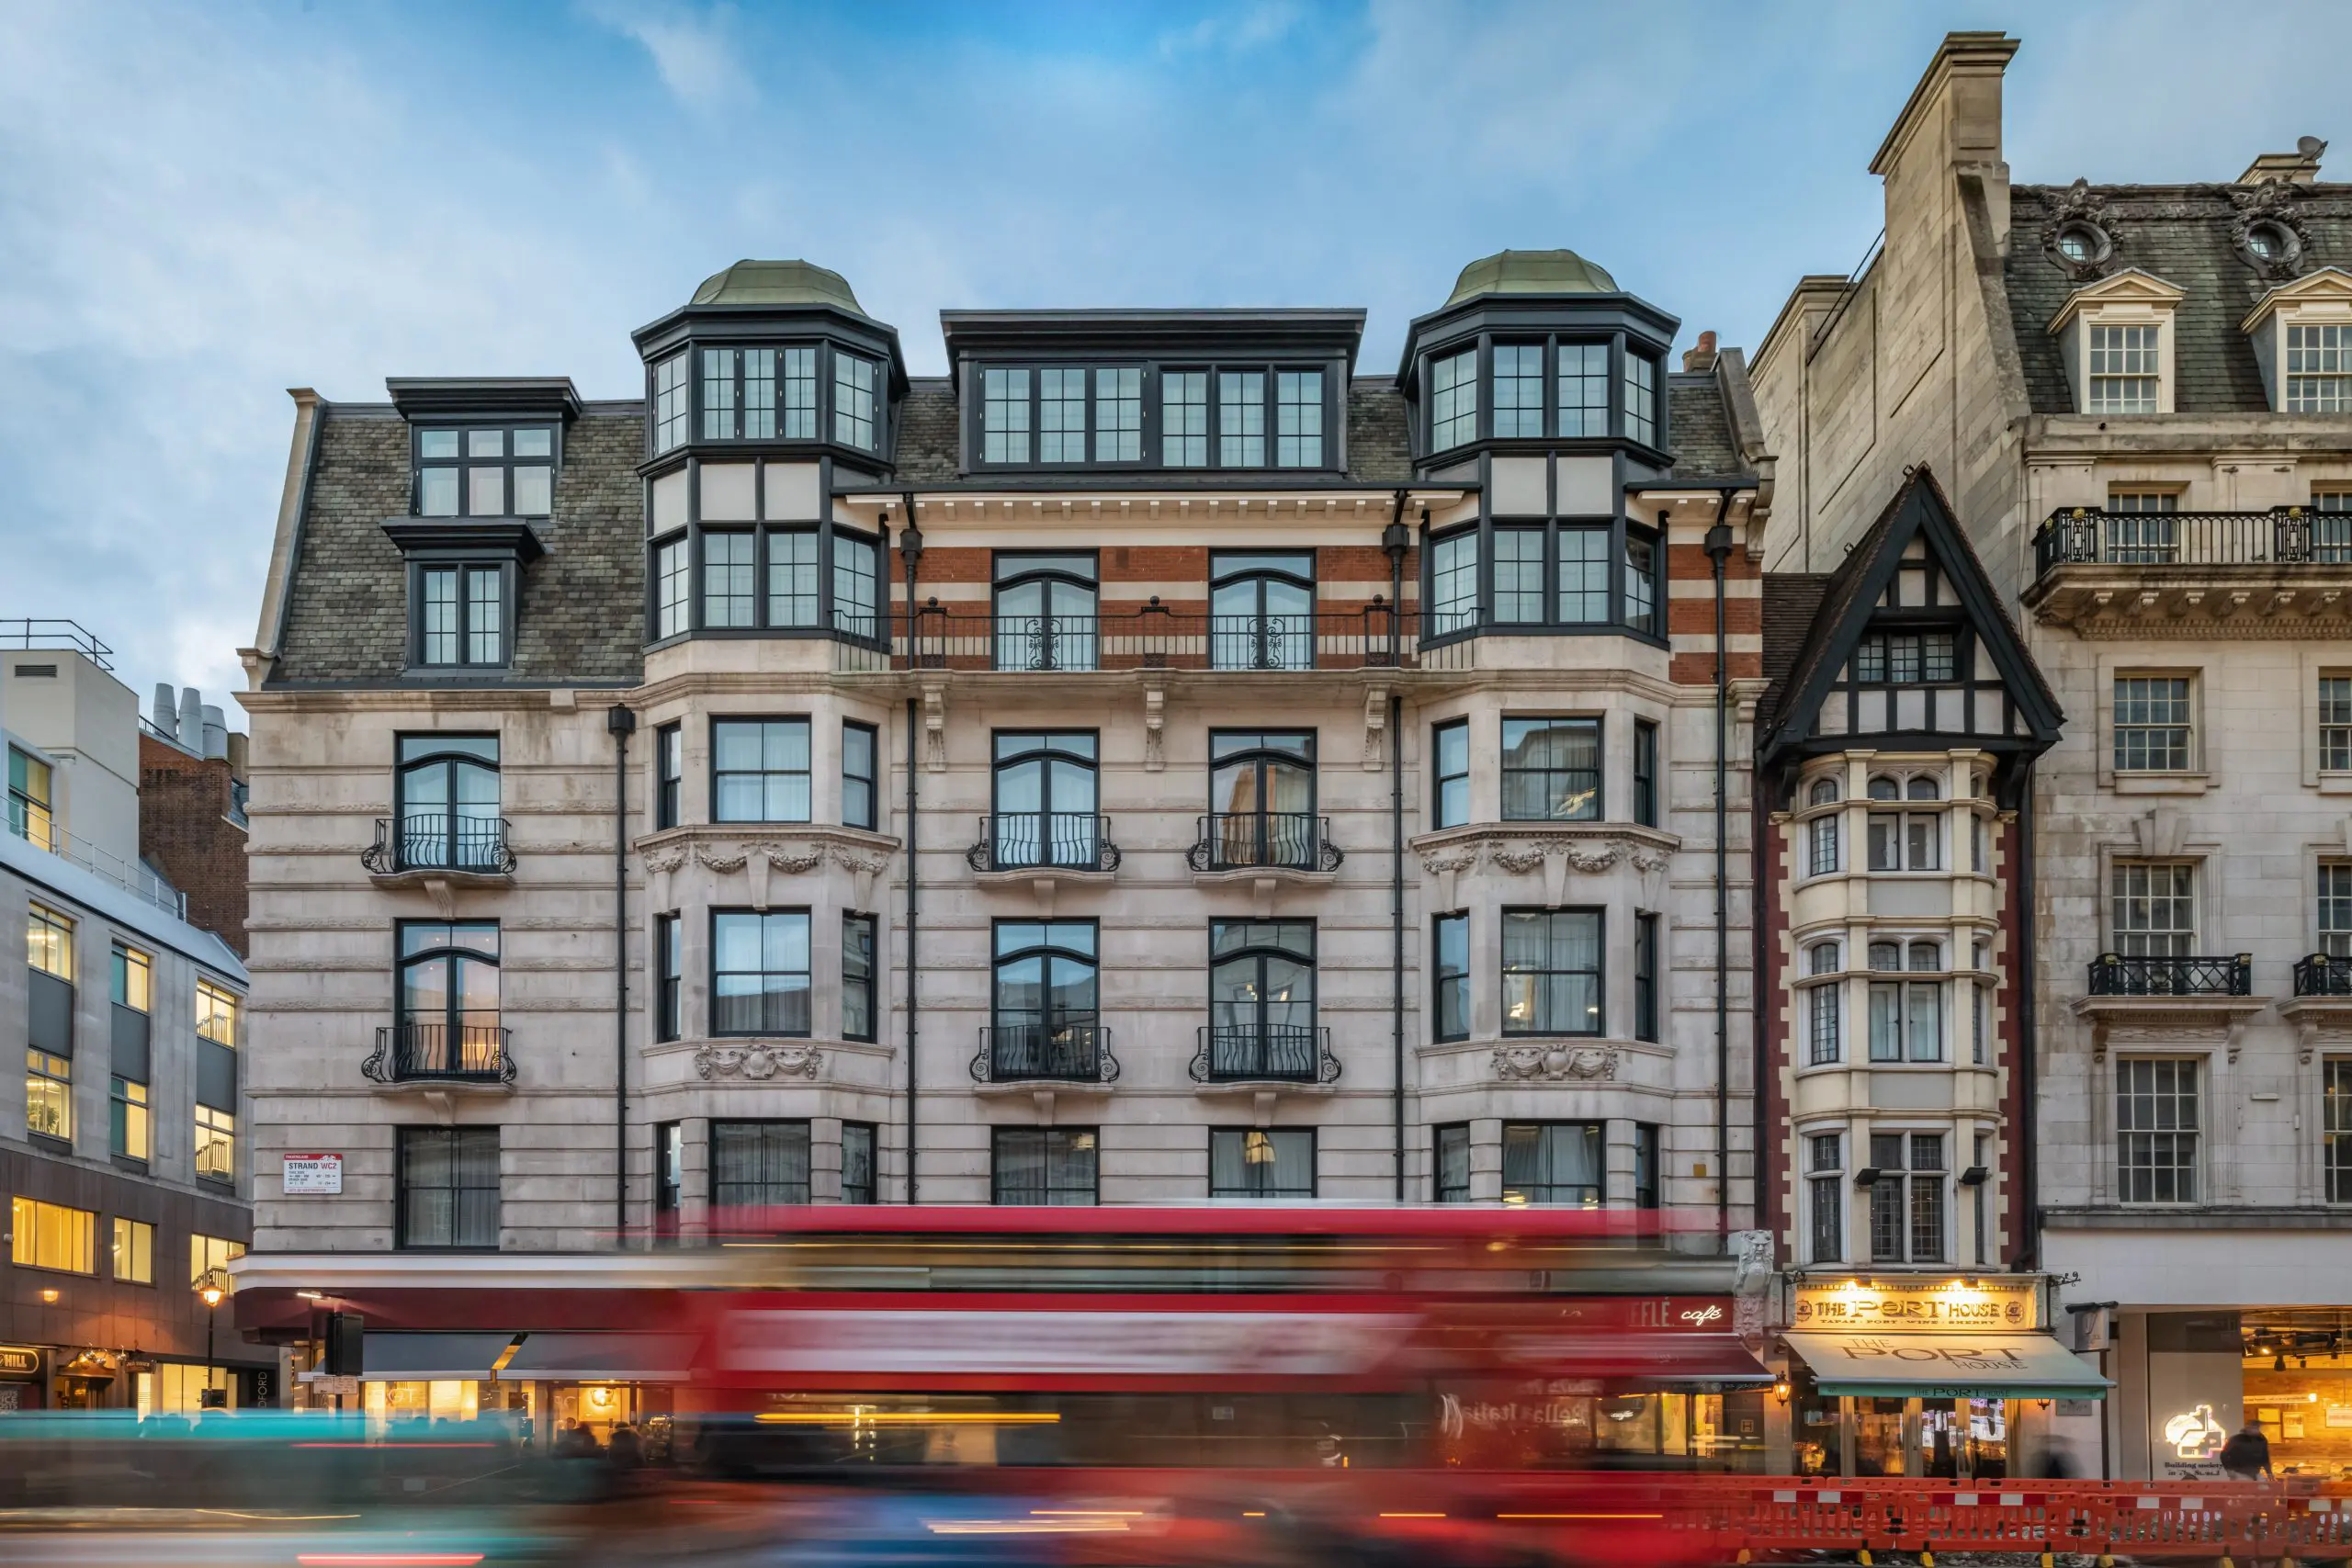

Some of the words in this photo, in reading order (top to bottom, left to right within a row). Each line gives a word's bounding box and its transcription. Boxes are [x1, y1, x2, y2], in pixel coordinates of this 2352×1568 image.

[1815, 1301, 1847, 1316] THE
[1850, 1299, 1945, 1317] PORT
[1949, 1302, 2000, 1317] HOUSE
[1680, 1304, 1722, 1326] café
[1847, 1337, 1894, 1348] THE
[1840, 1346, 2025, 1361] PORT
[4, 1354, 27, 1368] HILL
[1951, 1360, 2030, 1370] HOUSE
[1915, 1388, 1929, 1396] THE
[1933, 1388, 1983, 1396] PORT
[2165, 1461, 2197, 1470] Building
